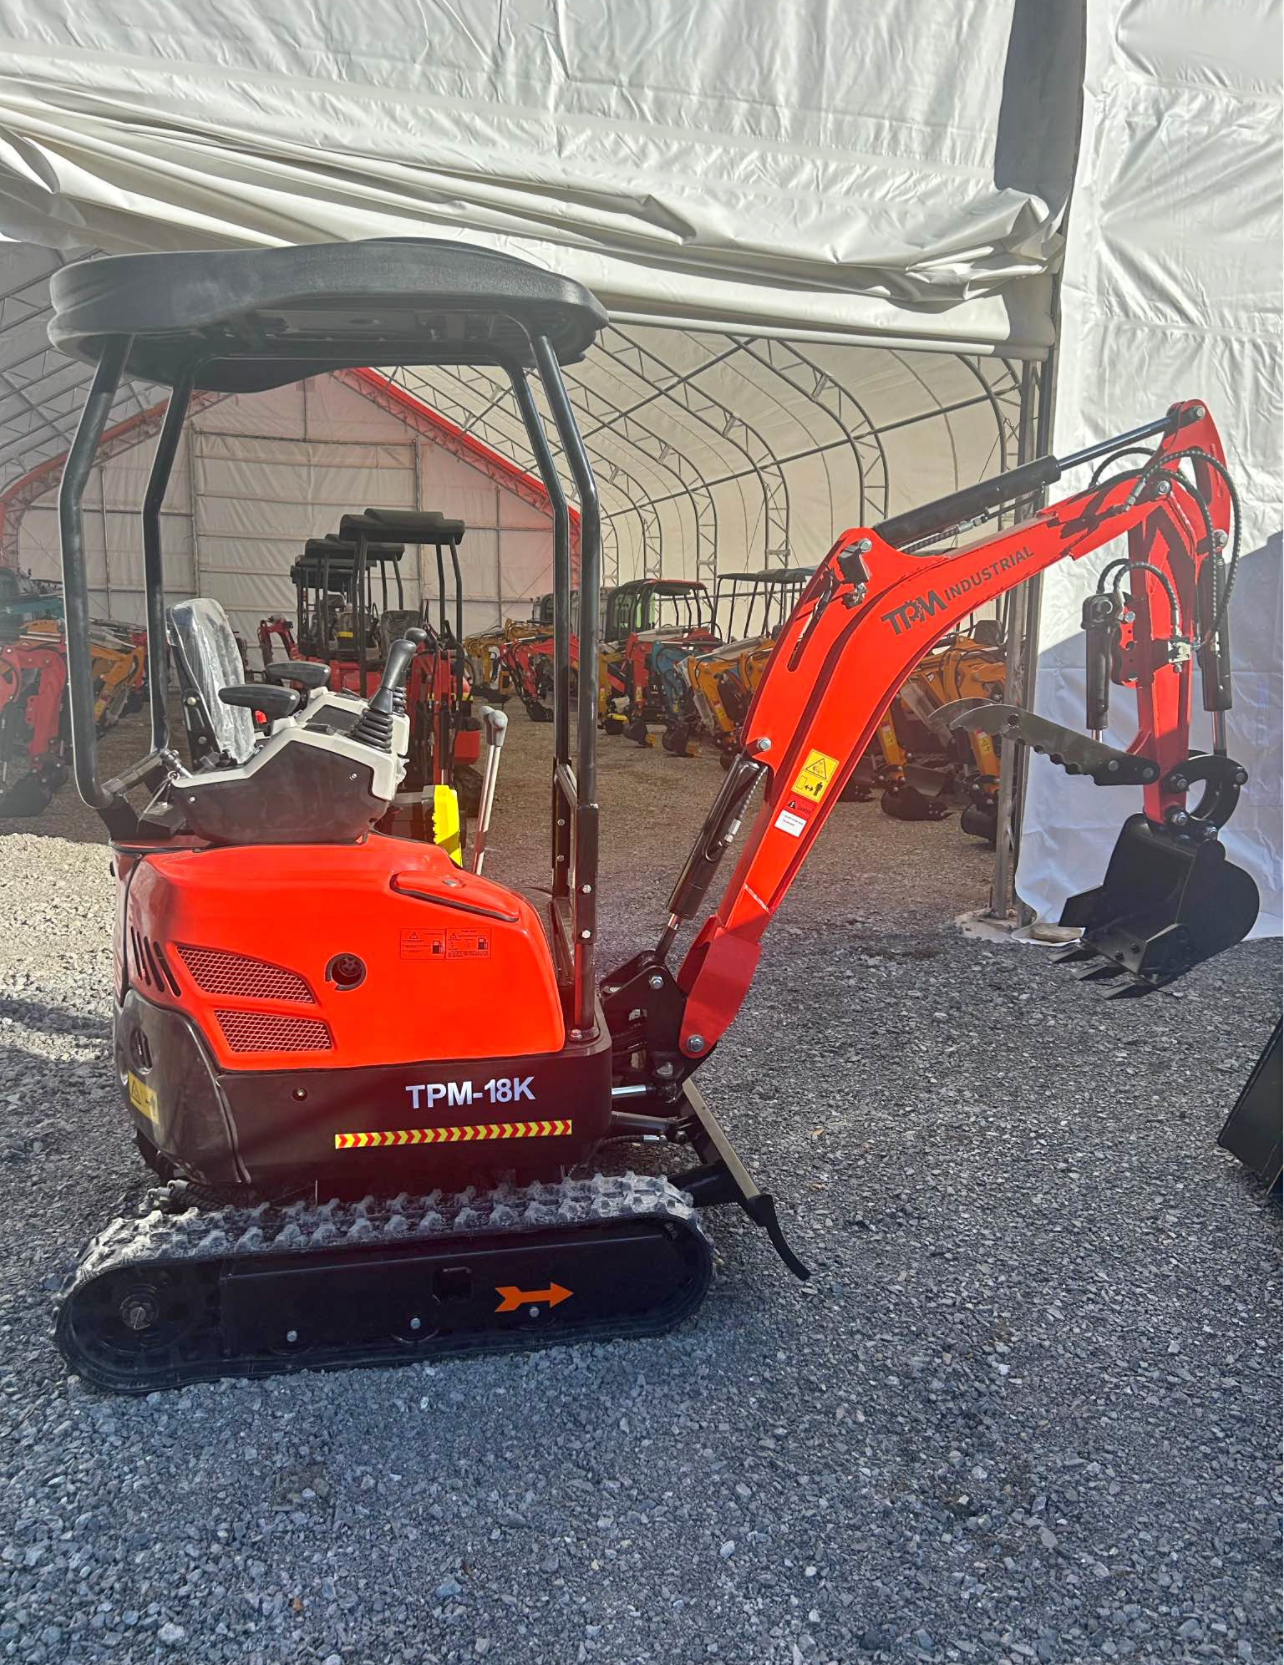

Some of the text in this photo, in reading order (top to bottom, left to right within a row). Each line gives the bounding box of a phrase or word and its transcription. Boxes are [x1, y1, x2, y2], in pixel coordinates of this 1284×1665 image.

[881, 545, 1035, 636] TPM INDUSTRIAL
[405, 1076, 536, 1109] TPM-18K
